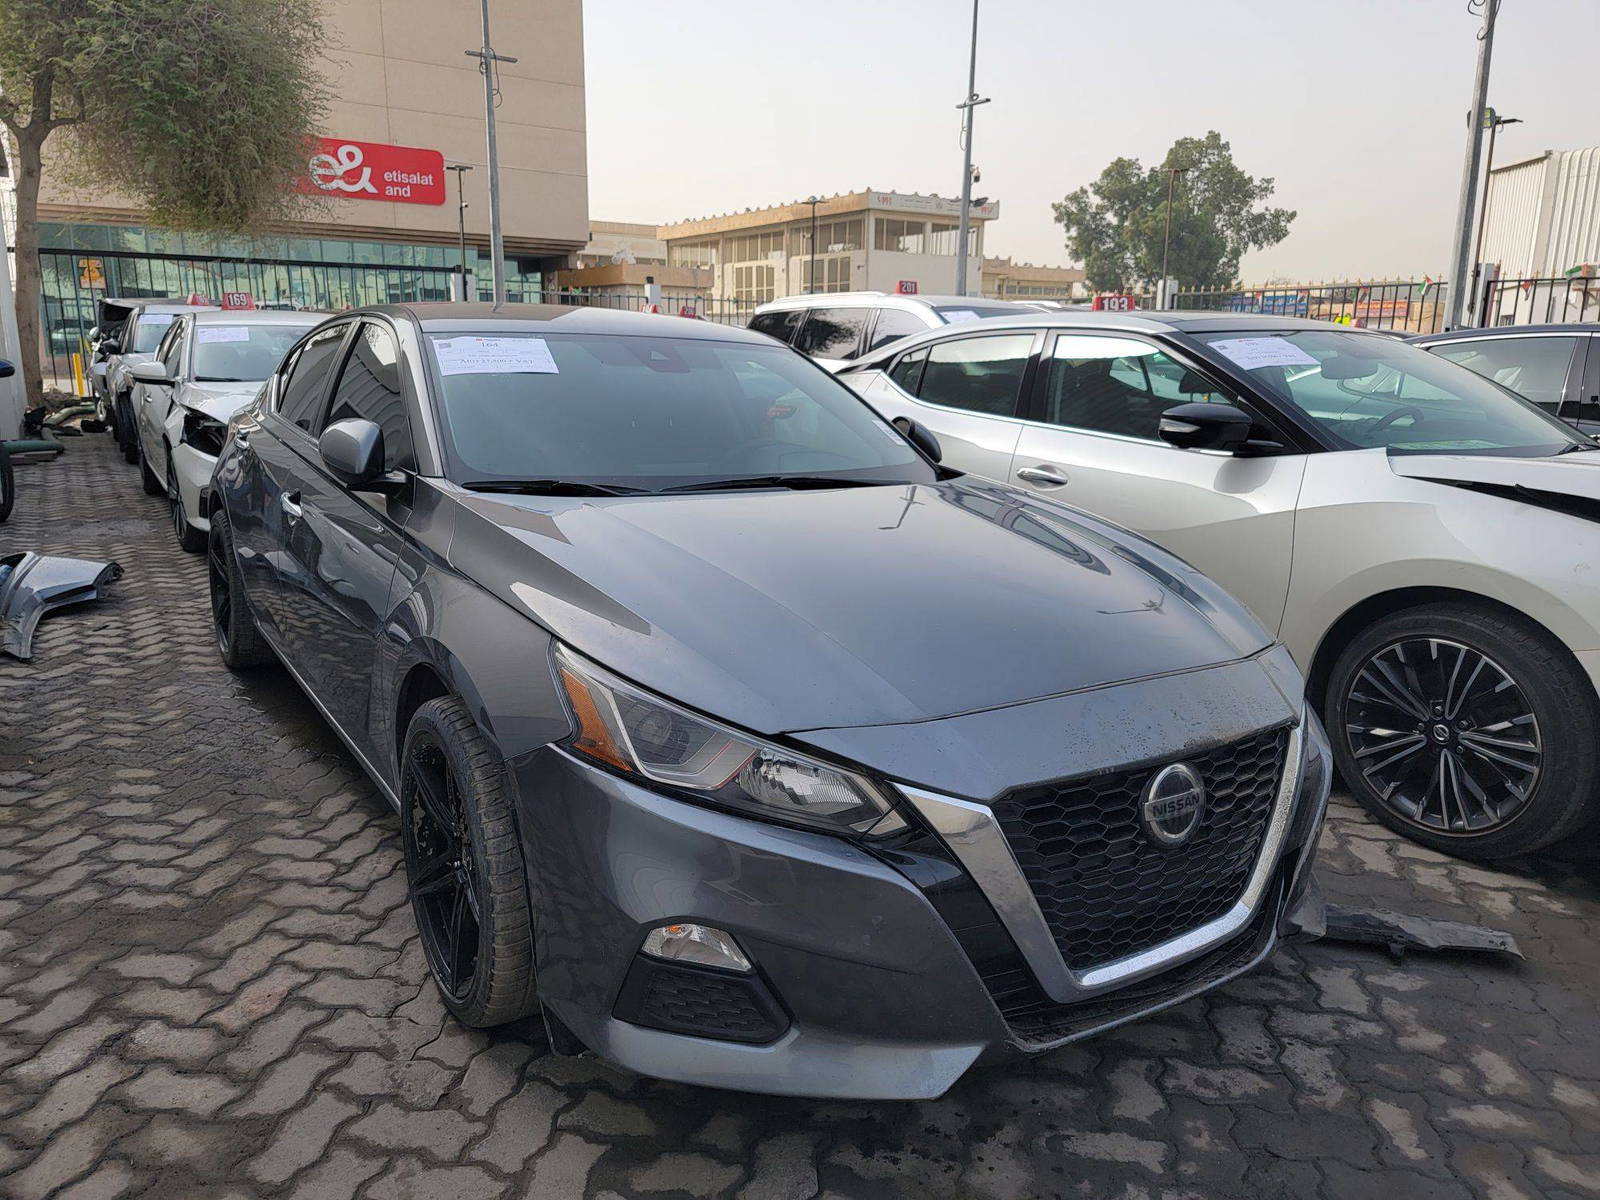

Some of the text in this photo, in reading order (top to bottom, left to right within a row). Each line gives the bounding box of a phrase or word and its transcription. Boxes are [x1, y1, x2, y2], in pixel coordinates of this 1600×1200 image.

[383, 170, 434, 186] etisalat
[385, 185, 411, 198] and
[228, 293, 247, 306] 169
[1102, 297, 1128, 311] 193
[1152, 791, 1200, 816] NISSAN
